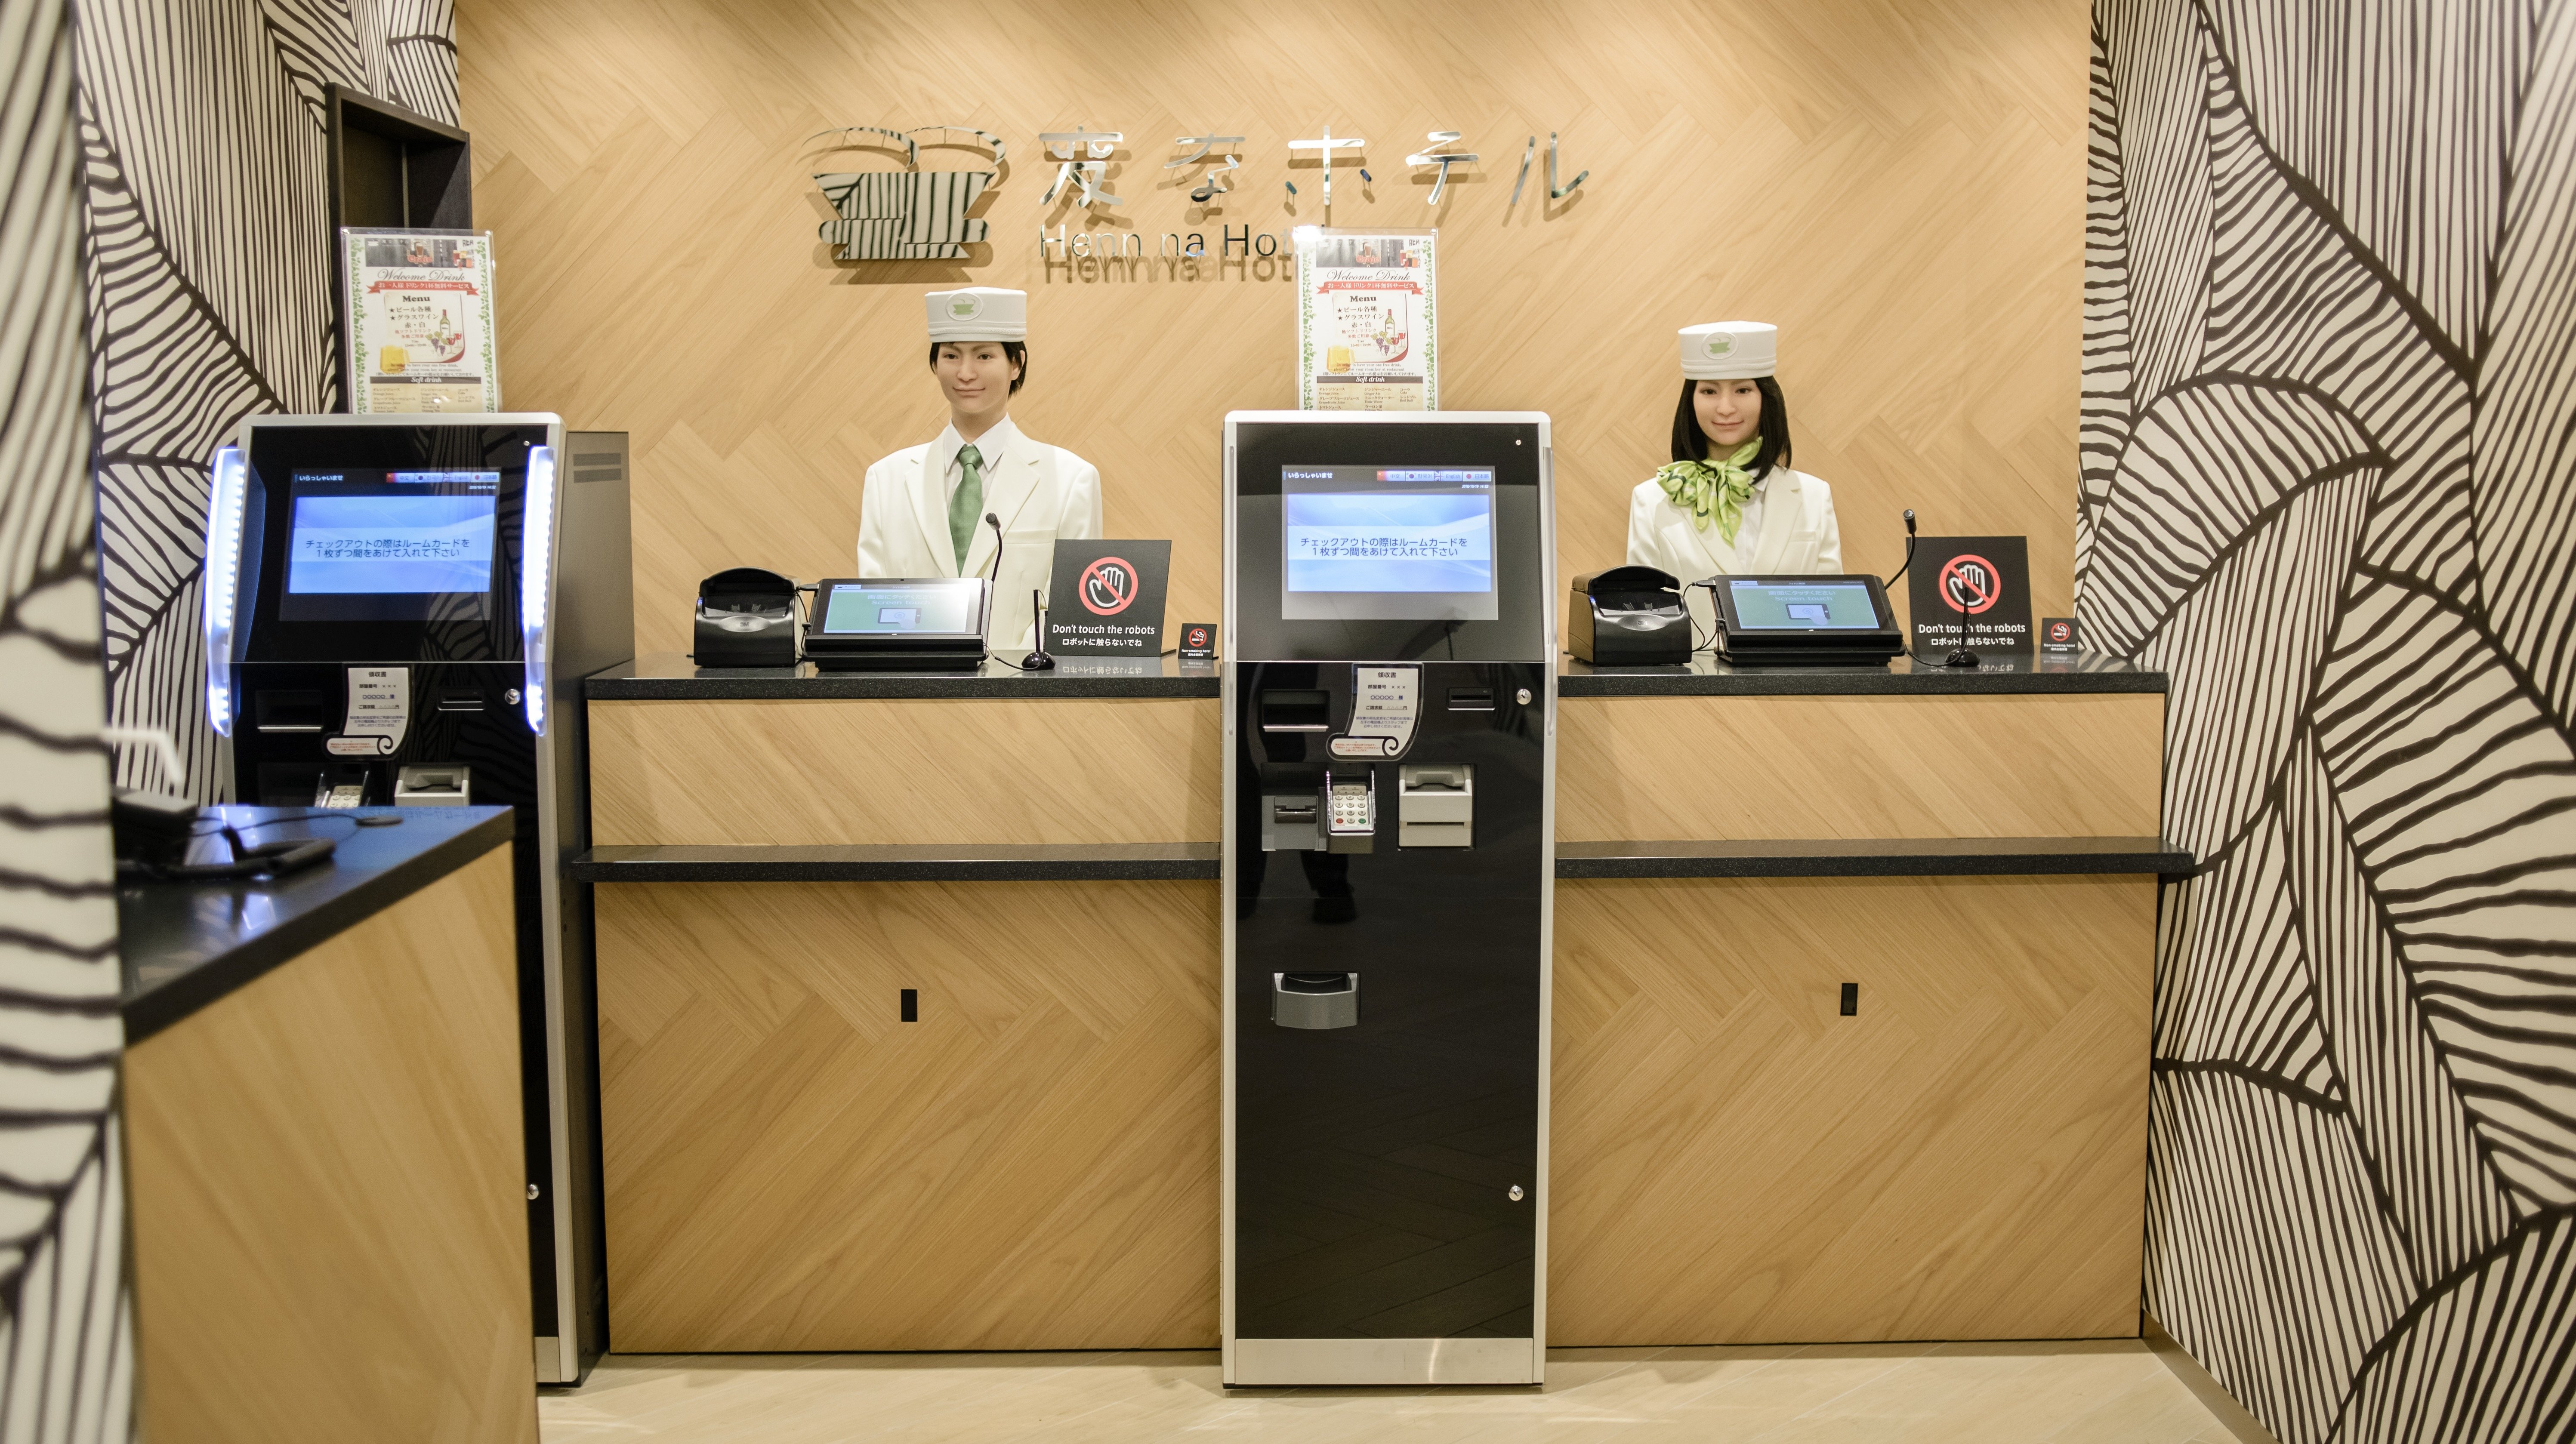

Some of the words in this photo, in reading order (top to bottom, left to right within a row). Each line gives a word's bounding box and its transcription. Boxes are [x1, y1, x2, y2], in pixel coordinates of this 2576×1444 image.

[1040, 224, 1141, 257] Henn
[1161, 233, 1204, 257] na
[1224, 224, 1293, 257] Hot
[377, 267, 426, 280] Welcome
[429, 269, 465, 281] Drink
[1327, 268, 1373, 280] Welcome
[1376, 269, 1410, 280] Drink
[306, 539, 470, 548] チェックアウトの際はルームカードを
[1301, 538, 1467, 547] チェックアウトの際はルームカードを
[1052, 624, 1077, 633] Don't
[1079, 625, 1104, 634] touch
[1108, 625, 1122, 634] the
[1125, 625, 1155, 634] robots
[1919, 624, 1944, 633] Don't
[1946, 624, 1973, 633] touh
[1976, 623, 1992, 632] the
[1994, 623, 2026, 633] robots
[1062, 638, 1142, 647] ロボットに触らないでね
